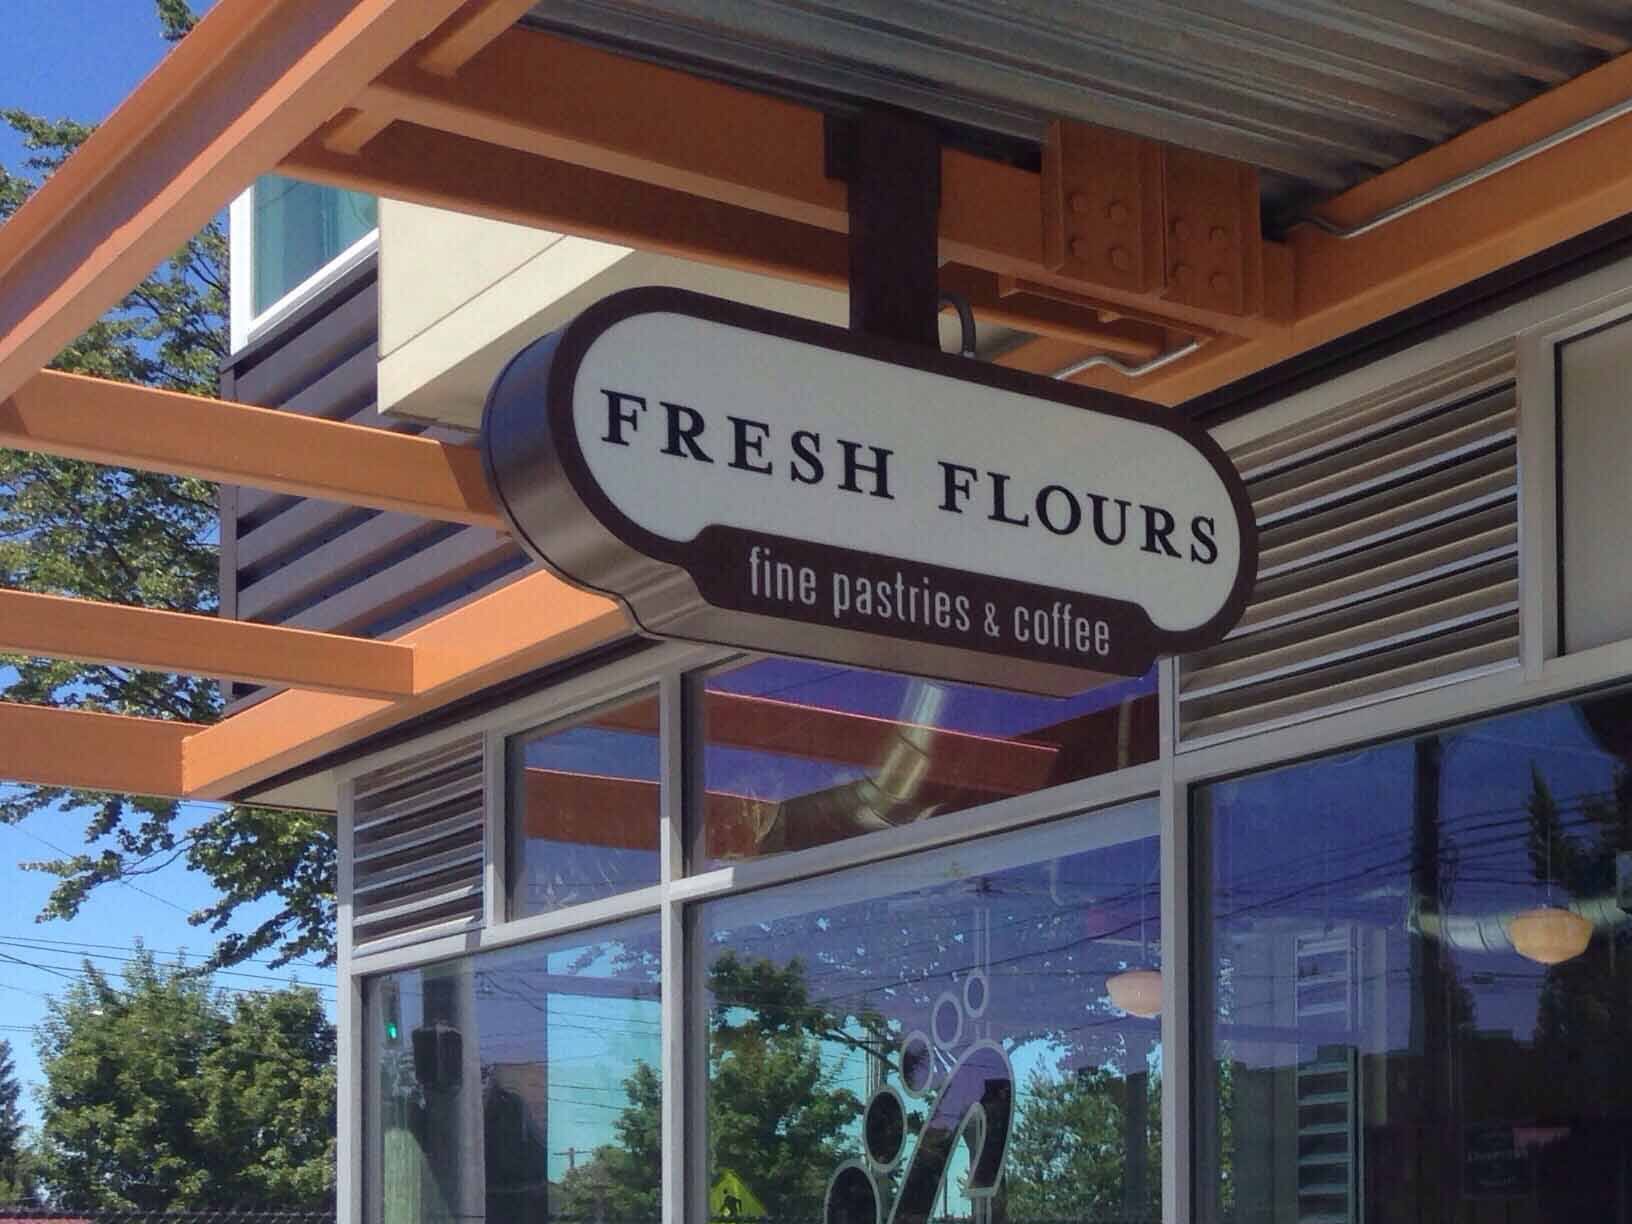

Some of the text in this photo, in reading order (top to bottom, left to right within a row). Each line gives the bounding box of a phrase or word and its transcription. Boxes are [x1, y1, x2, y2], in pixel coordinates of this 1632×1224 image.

[599, 388, 1219, 565] FRESH FLOURS
[749, 546, 1112, 656] fine pastries & coffee
